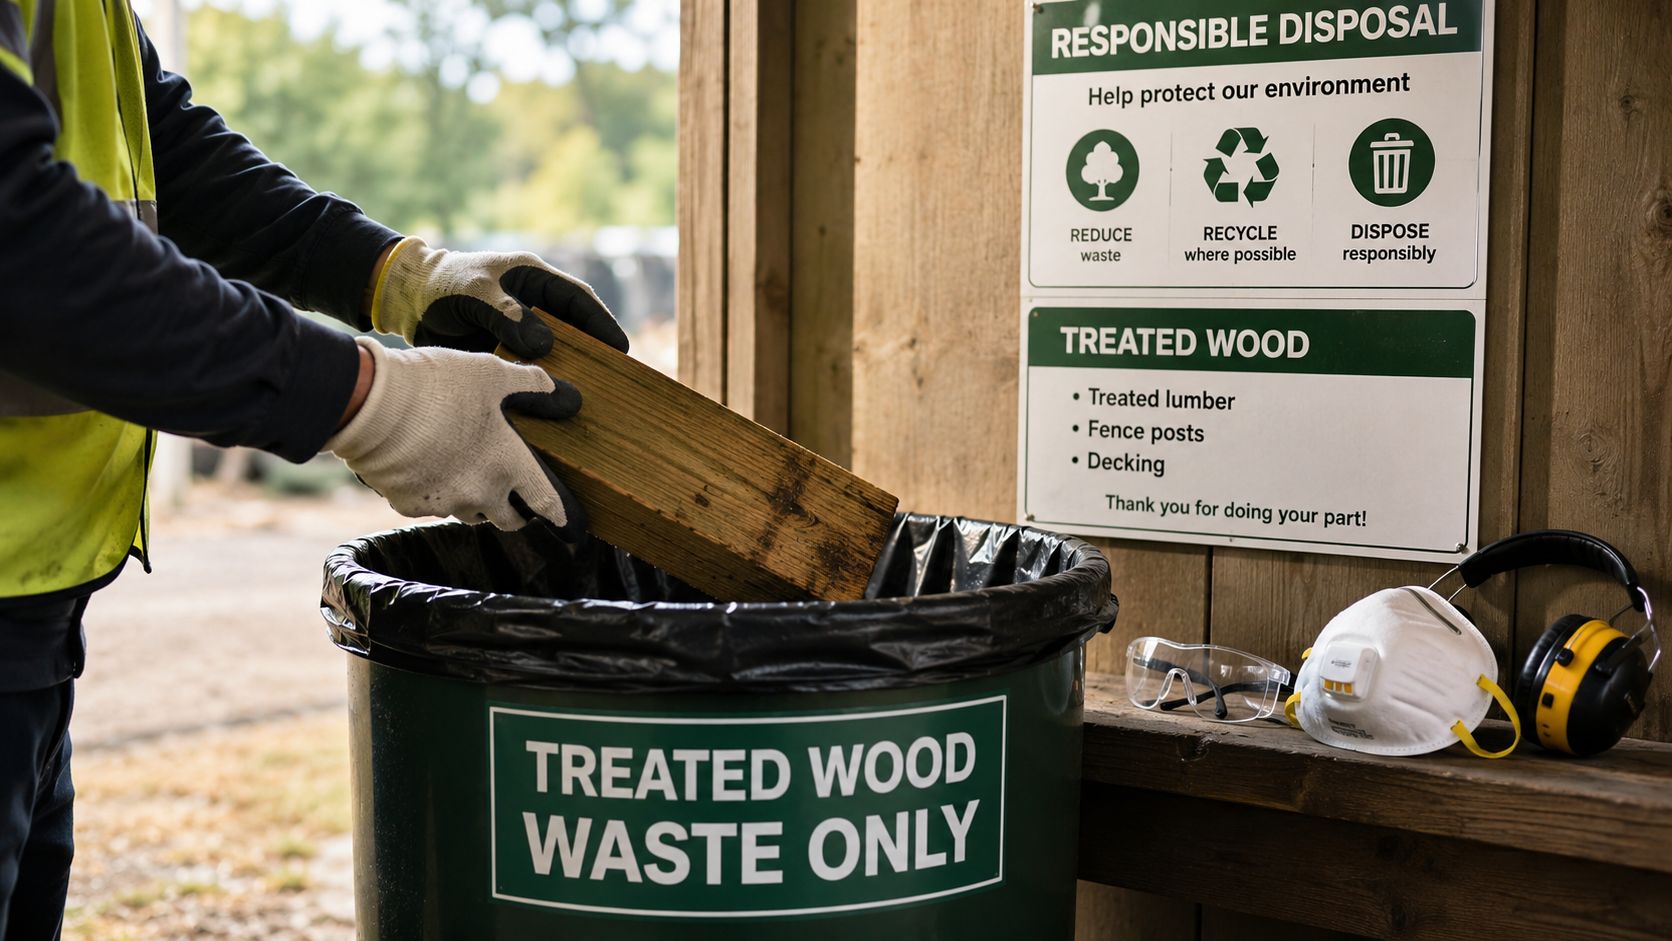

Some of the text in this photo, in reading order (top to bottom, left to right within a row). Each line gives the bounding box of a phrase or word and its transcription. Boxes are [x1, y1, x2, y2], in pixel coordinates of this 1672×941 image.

[1052, 3, 1457, 58] RESPONSIBLE DISPOSAL
[1089, 73, 1410, 108] Help protect our environment
[1071, 228, 1132, 241] REDUCE
[1204, 226, 1277, 240] RECYCLE
[1352, 223, 1429, 239] DISPOSE
[1081, 250, 1121, 261] waste
[1185, 247, 1296, 264] where possible
[1344, 245, 1436, 264] responsibly
[1060, 327, 1309, 358] TREATED WOOD
[1089, 388, 1235, 410] Treated lumber
[1089, 420, 1204, 444] Fence posts
[1089, 452, 1164, 477] Decking
[1106, 495, 1366, 528] Thank you for doing your part!
[526, 732, 977, 801] TREATED WOOD
[523, 799, 980, 884] WASTE ONLY
